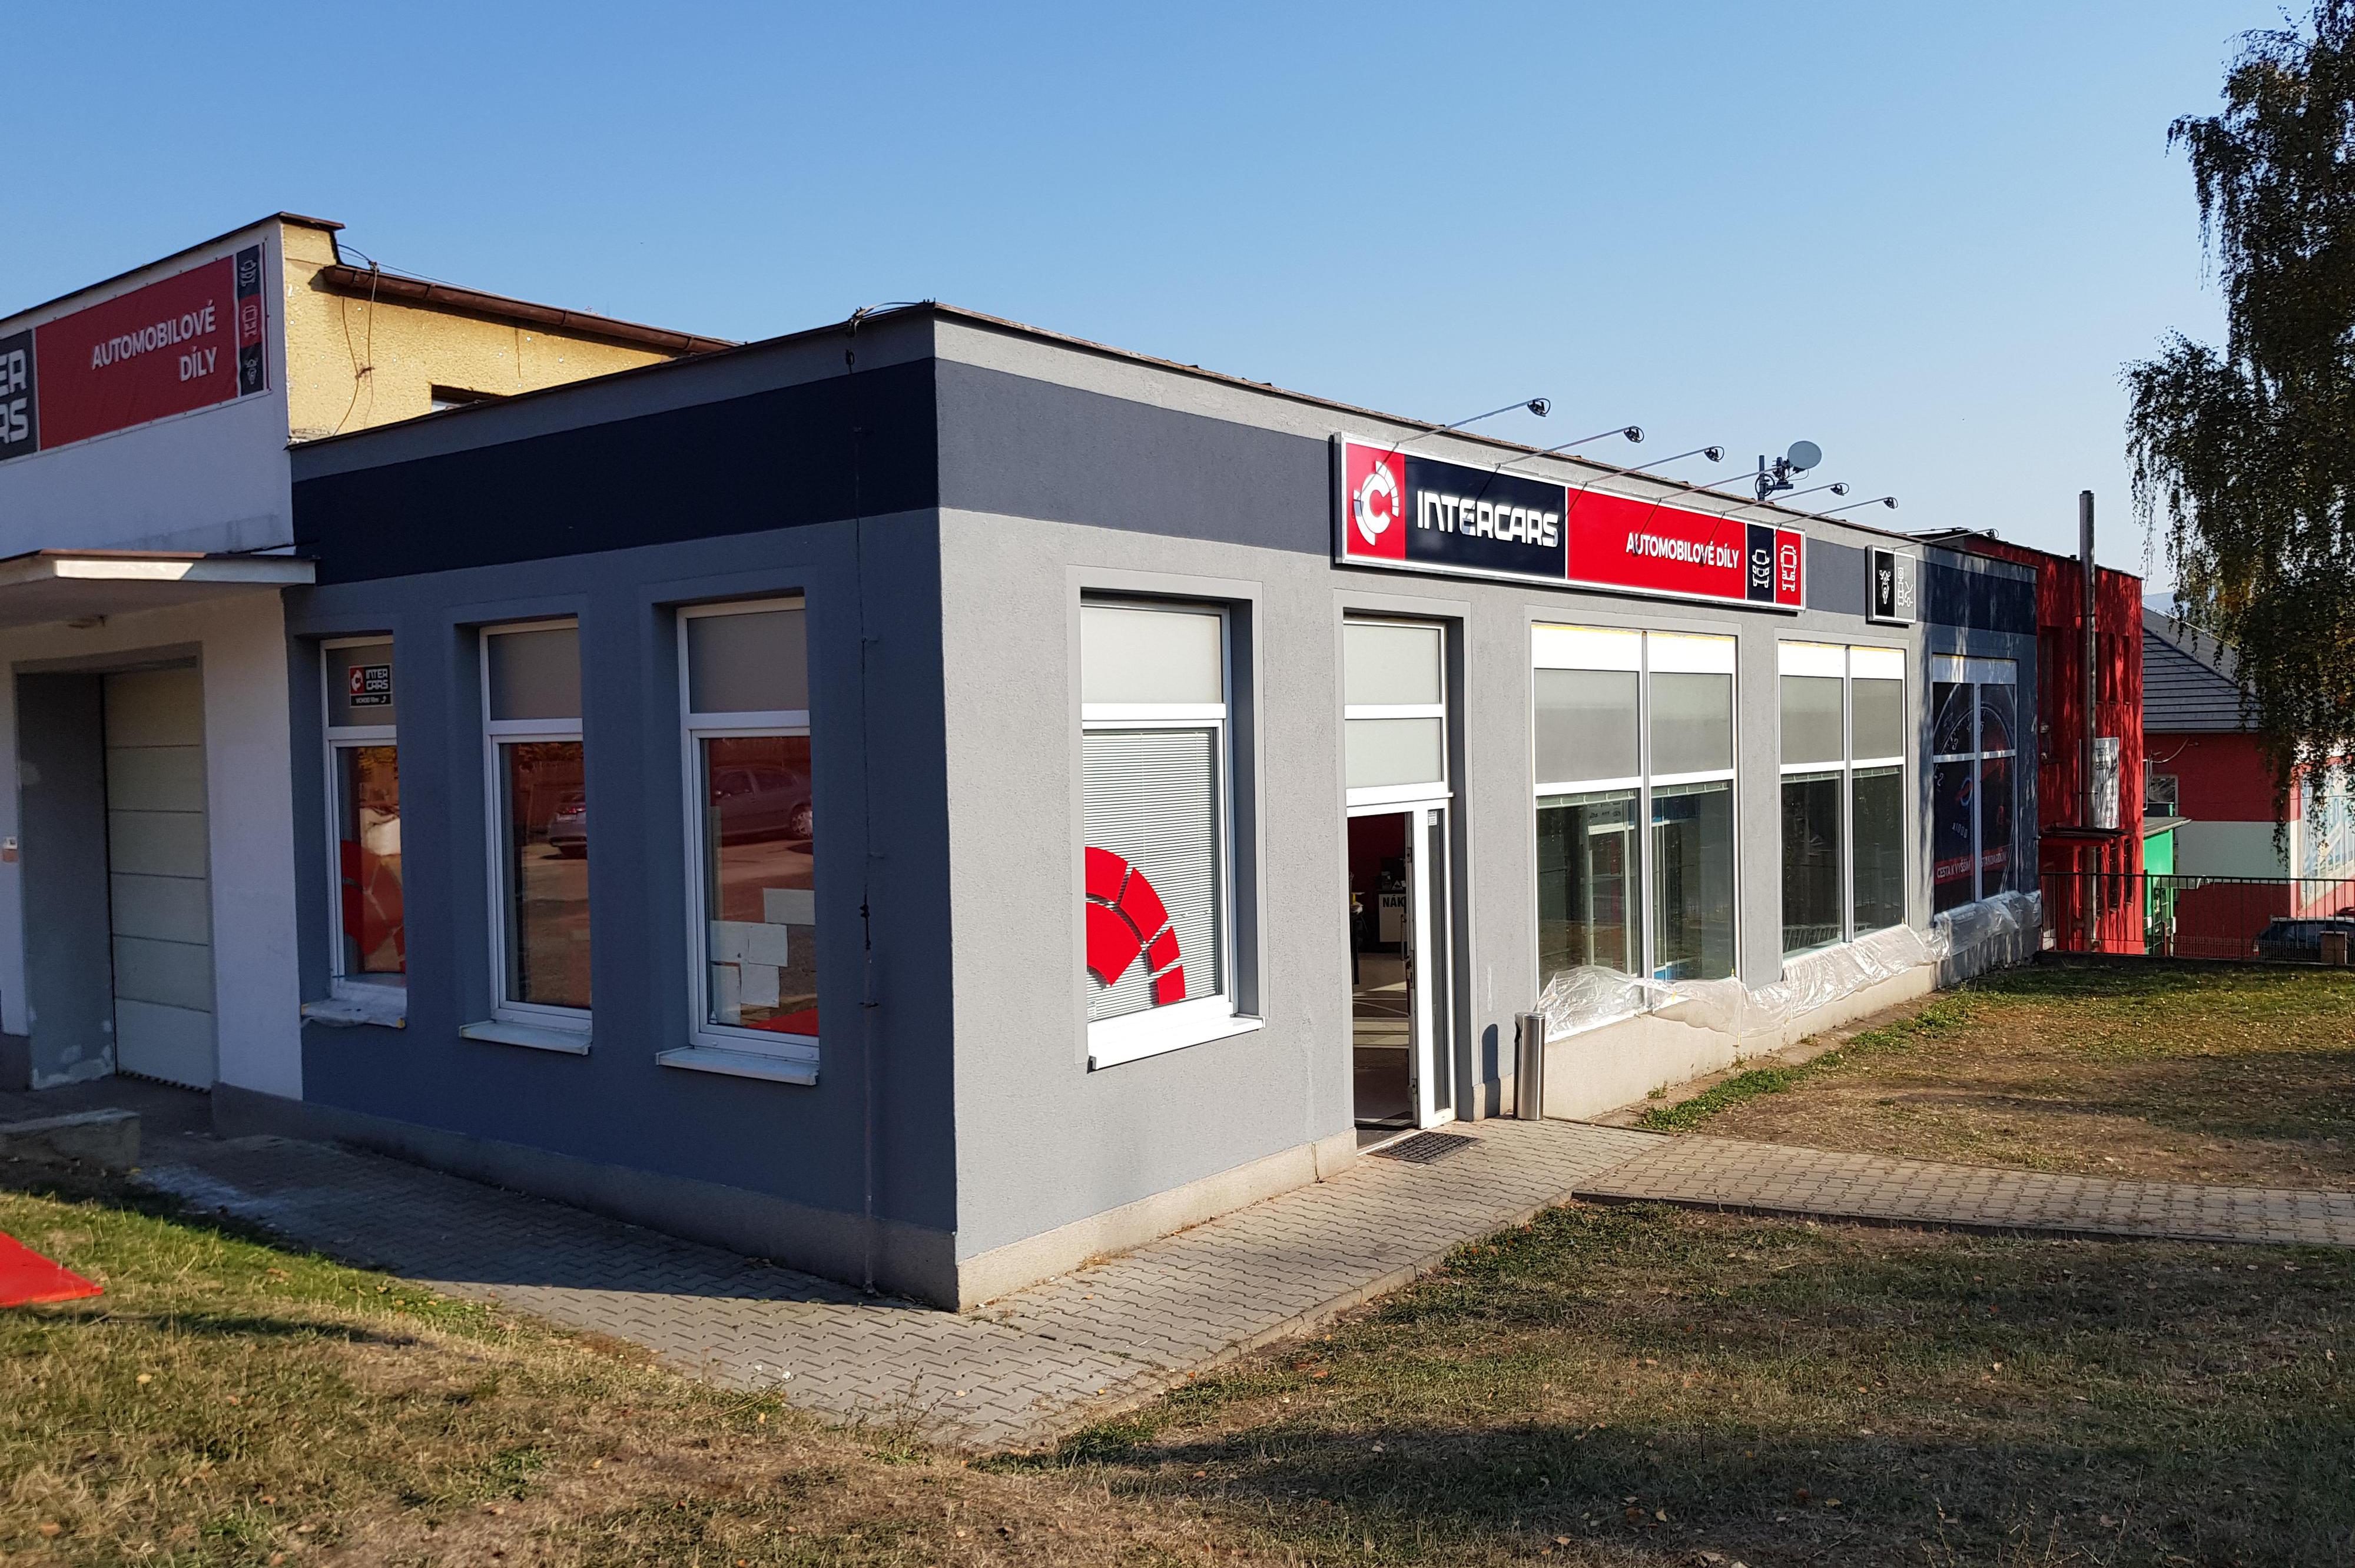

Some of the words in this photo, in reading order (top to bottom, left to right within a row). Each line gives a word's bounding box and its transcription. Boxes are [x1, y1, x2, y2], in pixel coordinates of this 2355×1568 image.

[92, 299, 216, 370] AUTOMOBILOVÉ
[180, 346, 217, 382] DÍLY
[1417, 490, 1558, 547] INTERCARS
[1626, 532, 1714, 566] AUTOMOBILOVÉ
[1716, 543, 1739, 569] DÍLY
[366, 668, 388, 679] INTER
[366, 679, 389, 690] CARS
[1952, 738, 1959, 750] 3
[1936, 772, 1944, 787] 2
[1936, 865, 1951, 879] CESTA
